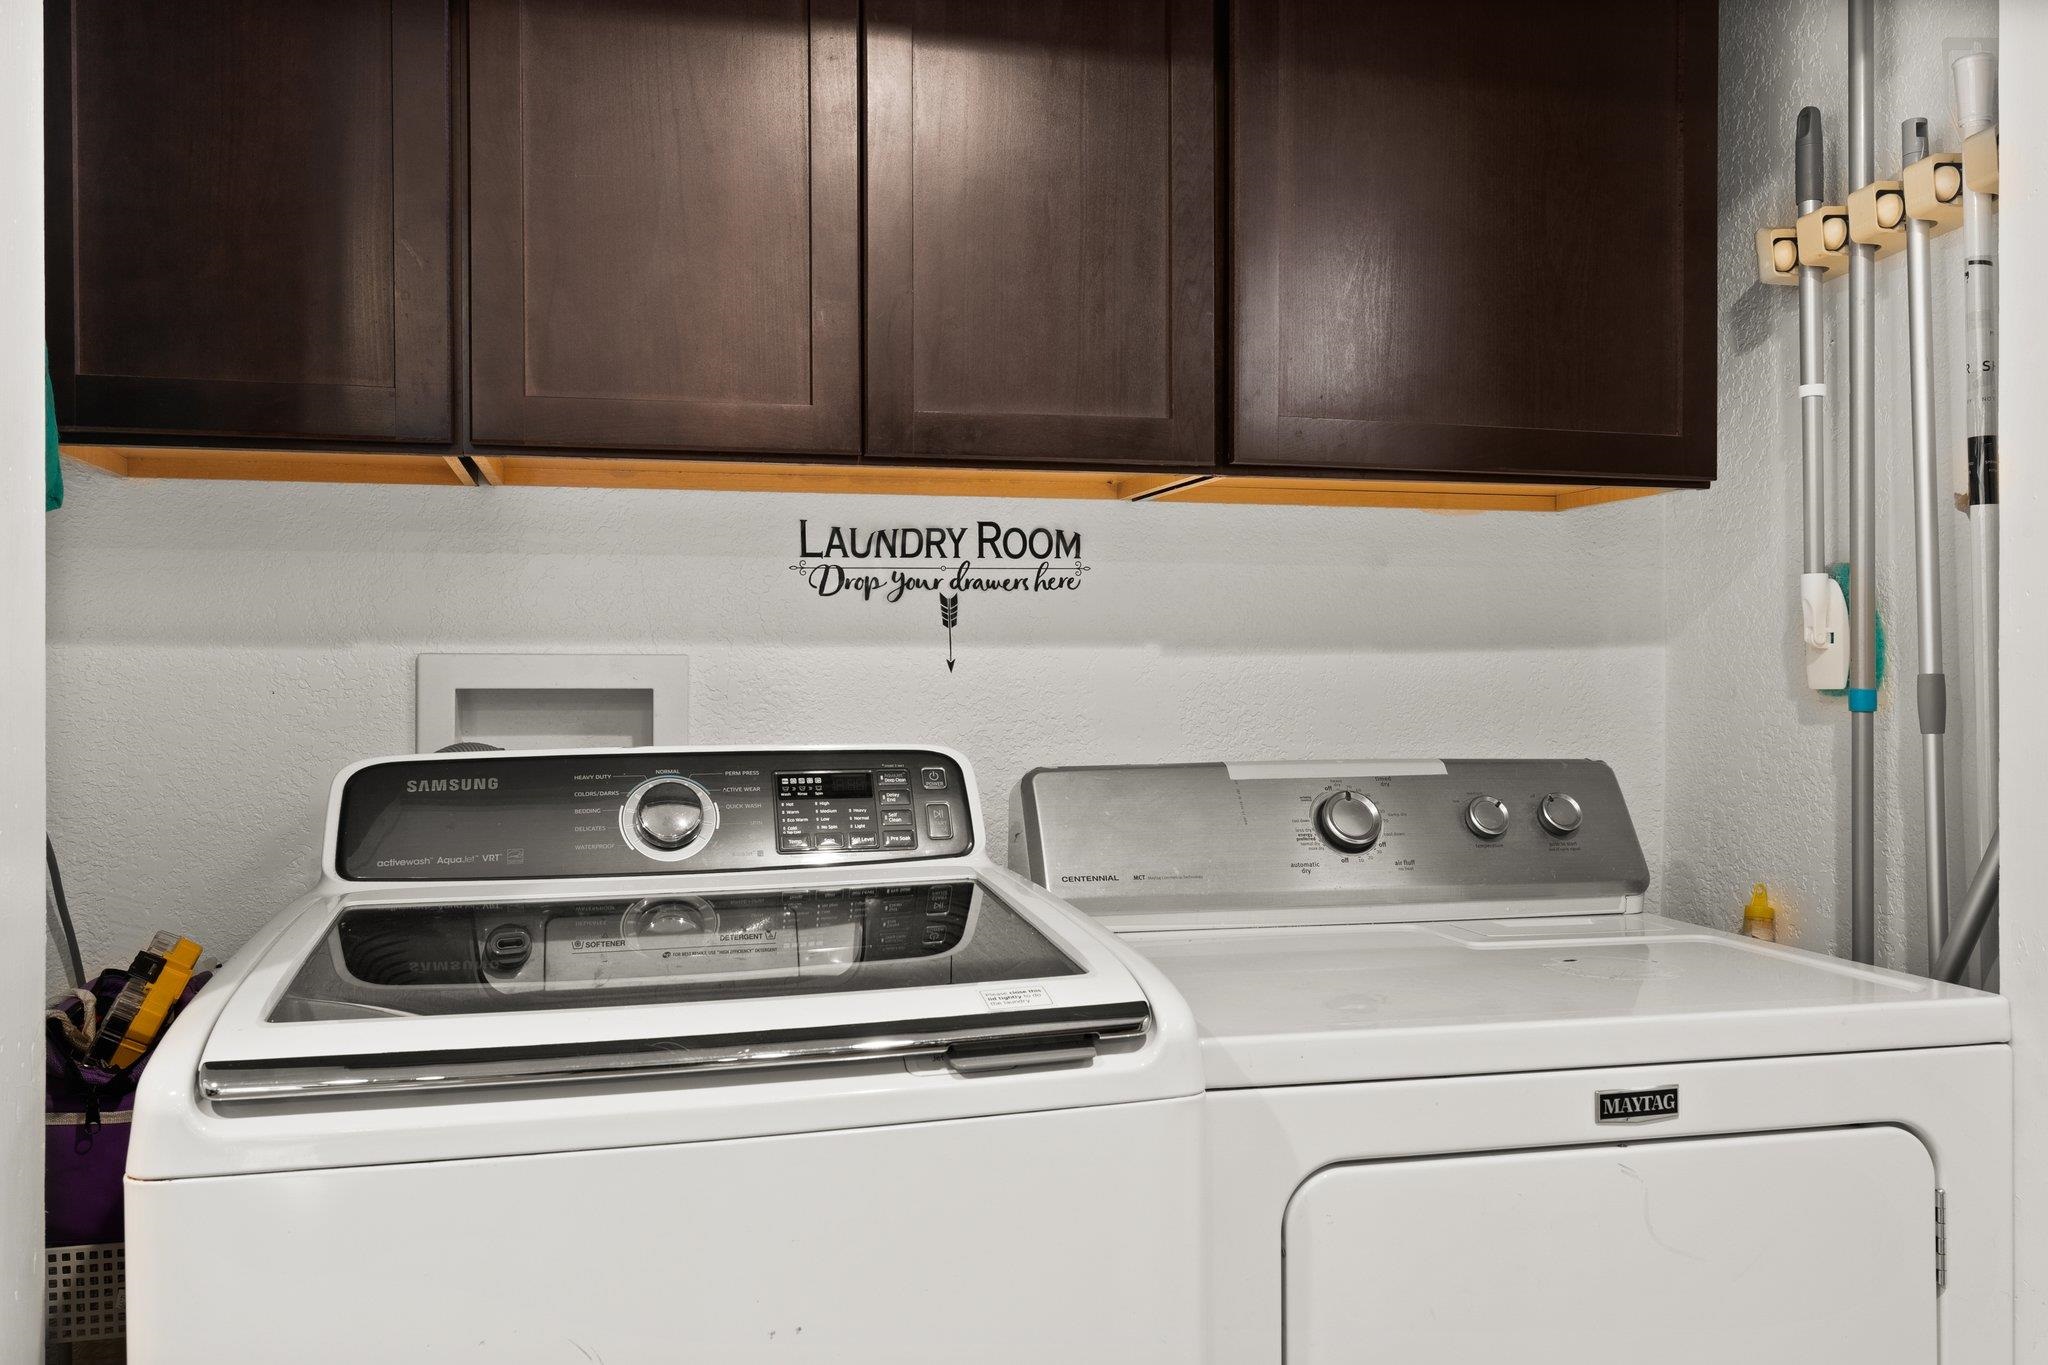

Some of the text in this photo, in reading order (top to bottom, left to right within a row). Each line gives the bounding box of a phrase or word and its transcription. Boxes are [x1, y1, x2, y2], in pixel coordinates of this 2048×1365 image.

[800, 519, 1082, 559] LAUNDRY ROOM
[808, 560, 1081, 602] Drop your drawers here
[407, 777, 499, 793] SAMSUNG
[376, 857, 431, 867] activewash
[482, 854, 501, 862] VRT
[1061, 874, 1120, 883] CENTENNIAL
[585, 940, 626, 948] SOFTENER
[719, 933, 763, 942] DETERGENT
[1602, 1094, 1675, 1114] MAYTAG
